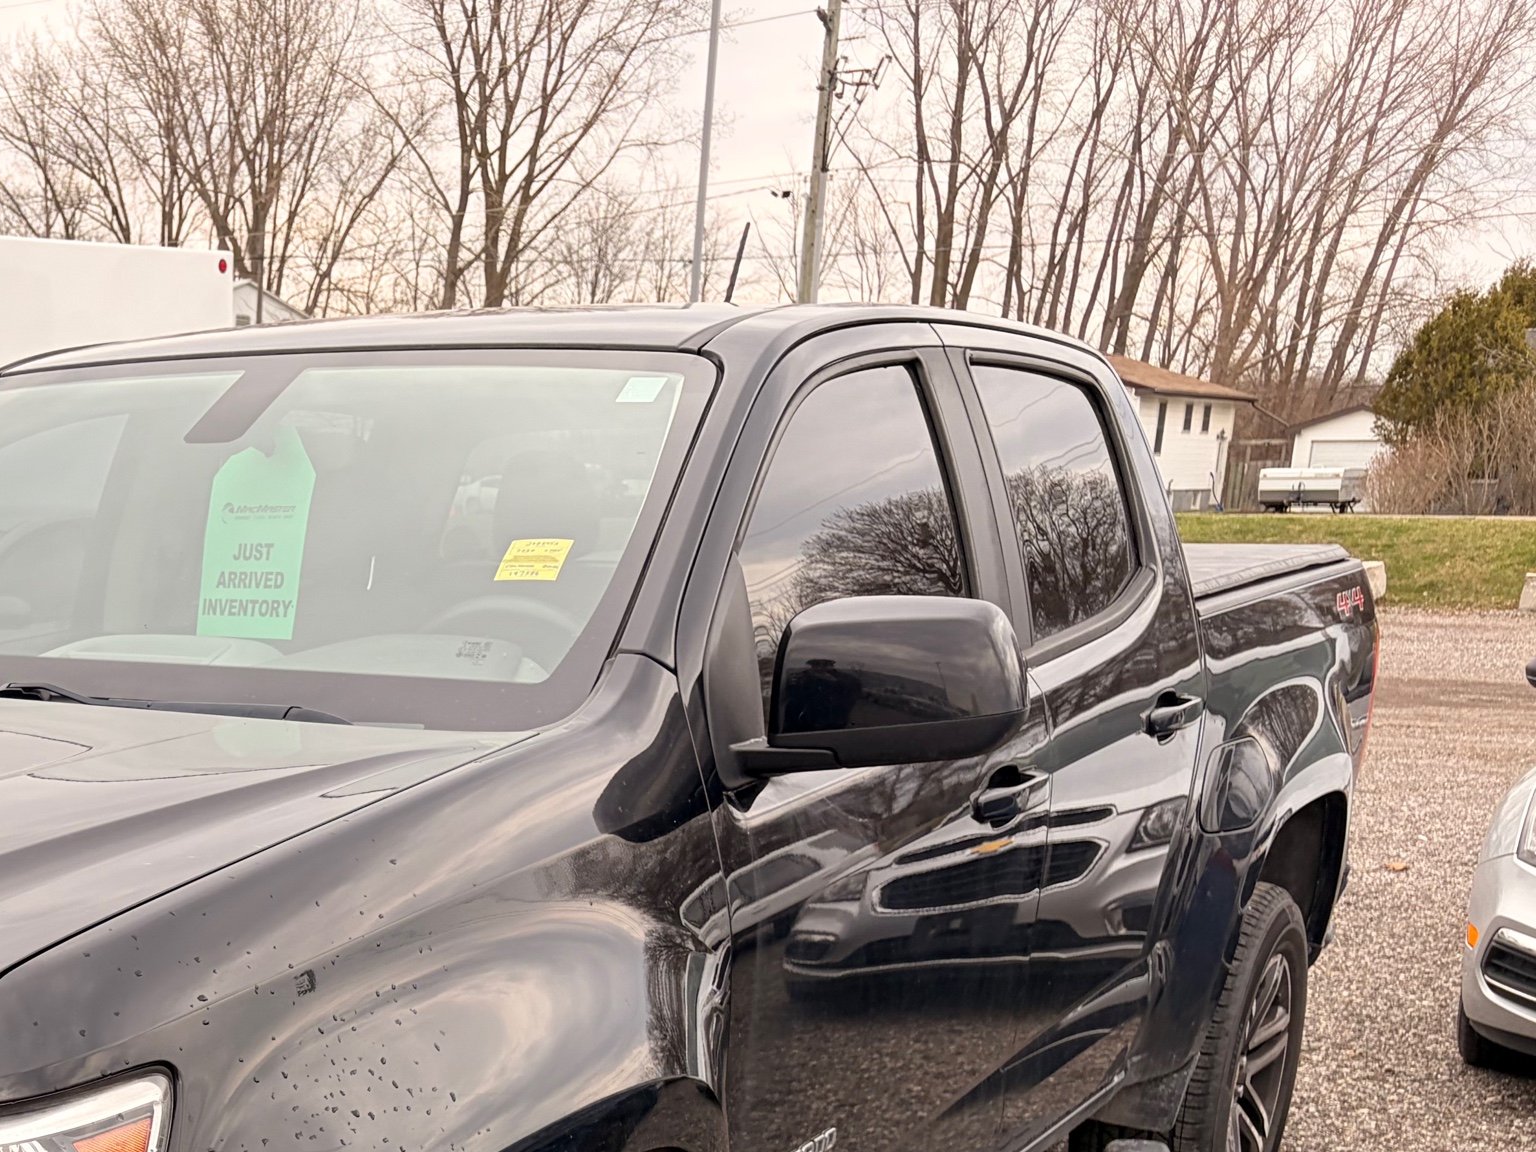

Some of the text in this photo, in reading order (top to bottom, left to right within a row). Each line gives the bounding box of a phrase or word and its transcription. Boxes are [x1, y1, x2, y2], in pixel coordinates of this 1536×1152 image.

[232, 543, 275, 561] JUST
[215, 571, 285, 589] ARRIVED
[202, 598, 293, 618] INVENTORY
